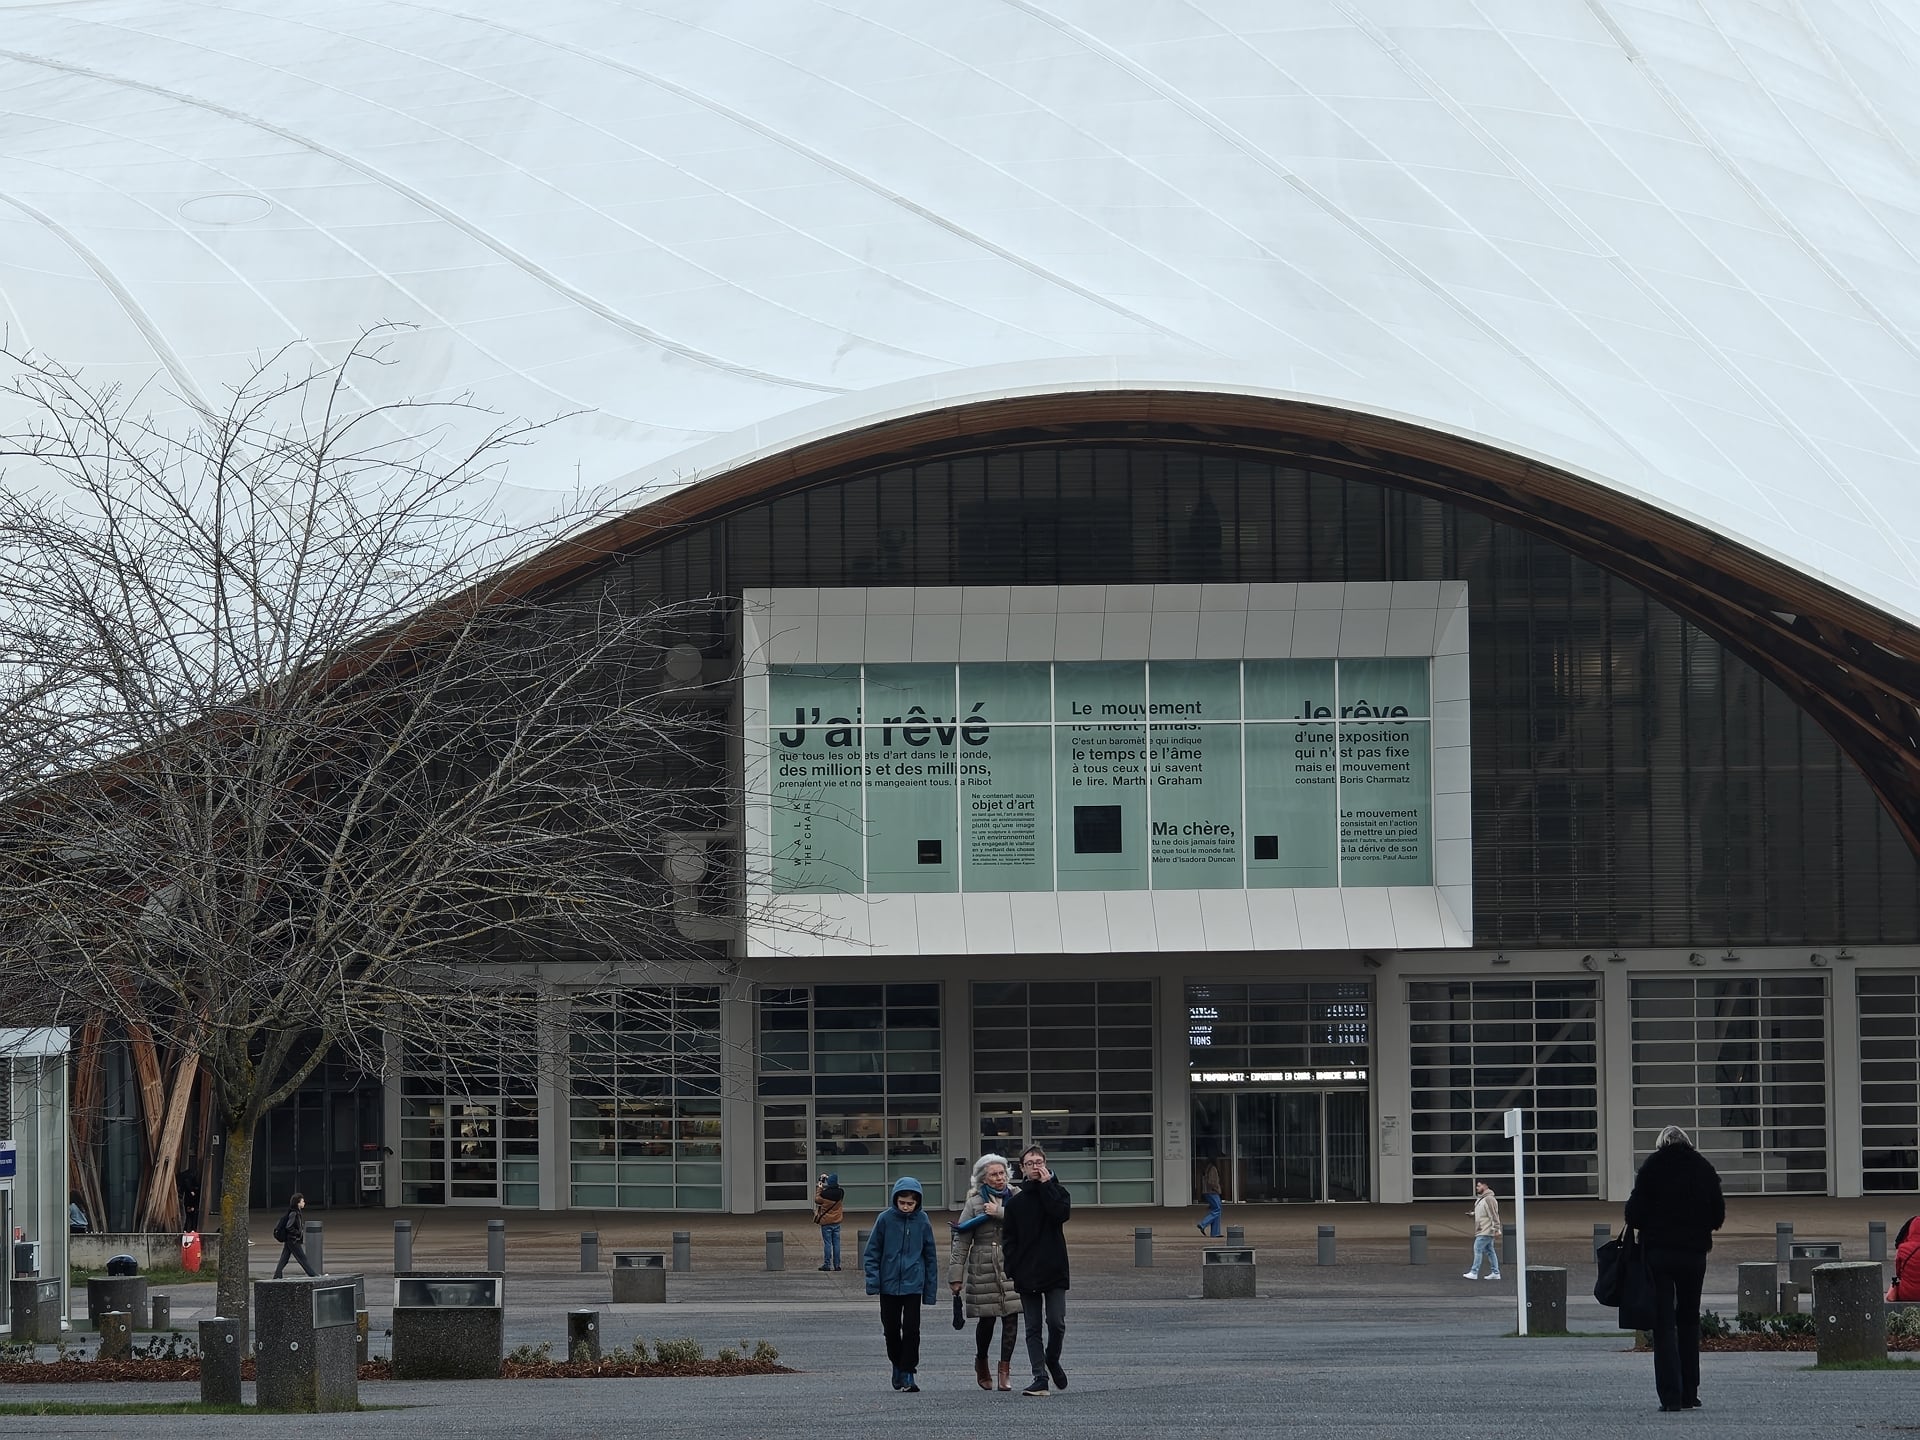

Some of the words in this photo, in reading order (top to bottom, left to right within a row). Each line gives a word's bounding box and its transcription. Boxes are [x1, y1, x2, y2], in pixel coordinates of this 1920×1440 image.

[1072, 701, 1093, 715] Le
[1101, 700, 1202, 715] mouvement
[1294, 700, 1332, 726] Je
[1341, 700, 1409, 725] rêve
[779, 707, 862, 748] J’ai
[883, 702, 990, 747] rêvé
[1072, 737, 1094, 745] C’est
[1109, 737, 1154, 745] baromète
[1155, 737, 1169, 747] qui
[1171, 737, 1203, 747] indique
[1294, 731, 1334, 743] d’une
[1339, 730, 1409, 744] exposition
[779, 752, 799, 762] que
[802, 751, 825, 760] tous
[829, 751, 844, 760] les
[847, 751, 880, 762] obets
[883, 750, 907, 760] d’art
[911, 750, 936, 760] dans
[940, 750, 949, 759] le
[1072, 748, 1085, 760] le
[1089, 748, 1136, 763] temps
[1162, 747, 1203, 760] l’âme
[1295, 747, 1315, 760] qui
[1357, 748, 1382, 760] pas
[1385, 746, 1410, 758] fixe
[779, 763, 808, 776] des
[812, 763, 872, 776] millions
[875, 763, 891, 776] et
[895, 763, 923, 775] des
[927, 762, 991, 776] millions,
[1072, 763, 1079, 773] à
[1083, 764, 1108, 773] tous
[1112, 765, 1140, 773] ceux
[1165, 763, 1203, 773] savent
[1295, 762, 1322, 772] mais
[1342, 761, 1410, 772] mouvement
[779, 779, 821, 789] prenaient
[875, 779, 927, 789] mangeaient
[930, 778, 952, 787] tous.
[967, 777, 993, 786] Ribot
[1072, 777, 1082, 786] le
[1087, 777, 1108, 786] lire.
[1157, 775, 1203, 786] Graham
[1340, 775, 1364, 784] Boris
[1366, 775, 1410, 784] Charmatz
[972, 799, 1003, 812] objet
[1006, 799, 1035, 810] d’art
[1340, 809, 1353, 818] Le
[1356, 809, 1418, 818] mouvement
[804, 803, 812, 839] CHAIR
[793, 803, 802, 867] WALK
[1152, 822, 1178, 836] Ma
[1182, 820, 1235, 837] chère,
[1340, 828, 1351, 836] de
[1353, 828, 1382, 836] mettre
[1398, 828, 1418, 837] pied
[1173, 838, 1189, 846] dois
[1190, 838, 1217, 847] jamais
[1340, 844, 1346, 853] à
[1348, 845, 1356, 853] la
[1358, 844, 1386, 853] dérive
[1388, 845, 1399, 853] de
[804, 845, 812, 867] THE
